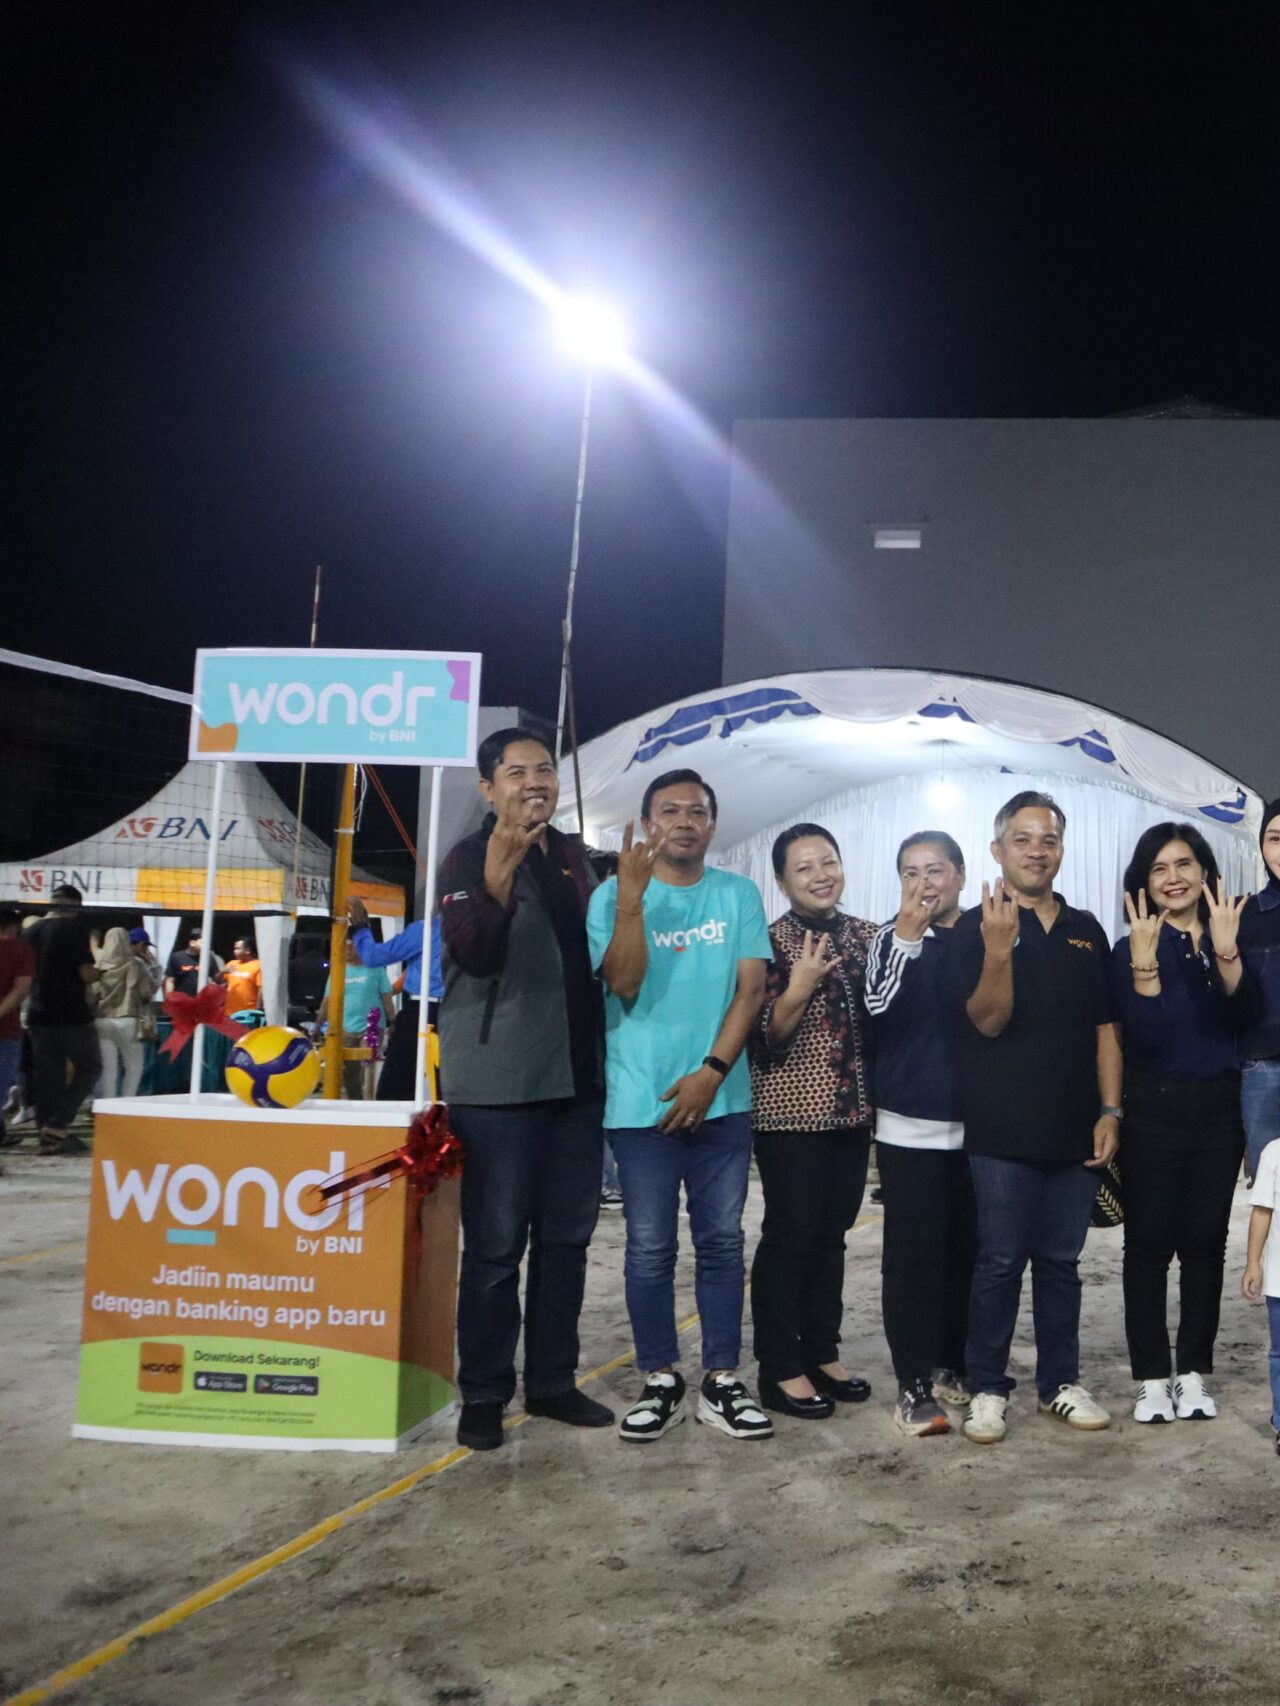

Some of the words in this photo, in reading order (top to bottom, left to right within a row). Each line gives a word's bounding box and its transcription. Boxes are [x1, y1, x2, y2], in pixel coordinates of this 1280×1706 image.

[228, 671, 436, 726] wondr
[369, 729, 386, 744] by
[389, 729, 416, 742] BNI
[156, 817, 239, 841] BNI
[51, 869, 102, 894] BNI
[652, 918, 727, 948] wondr
[102, 1151, 391, 1231] wondr
[296, 1234, 320, 1255] by
[324, 1237, 363, 1254] BNI
[152, 1265, 220, 1287] Jadiin
[226, 1272, 315, 1293] maumu
[91, 1291, 170, 1319] dengan
[176, 1297, 268, 1327] banking
[274, 1308, 321, 1330] app
[327, 1305, 386, 1327] baru
[193, 1350, 254, 1365] Download
[257, 1353, 320, 1369] Sekarang!
